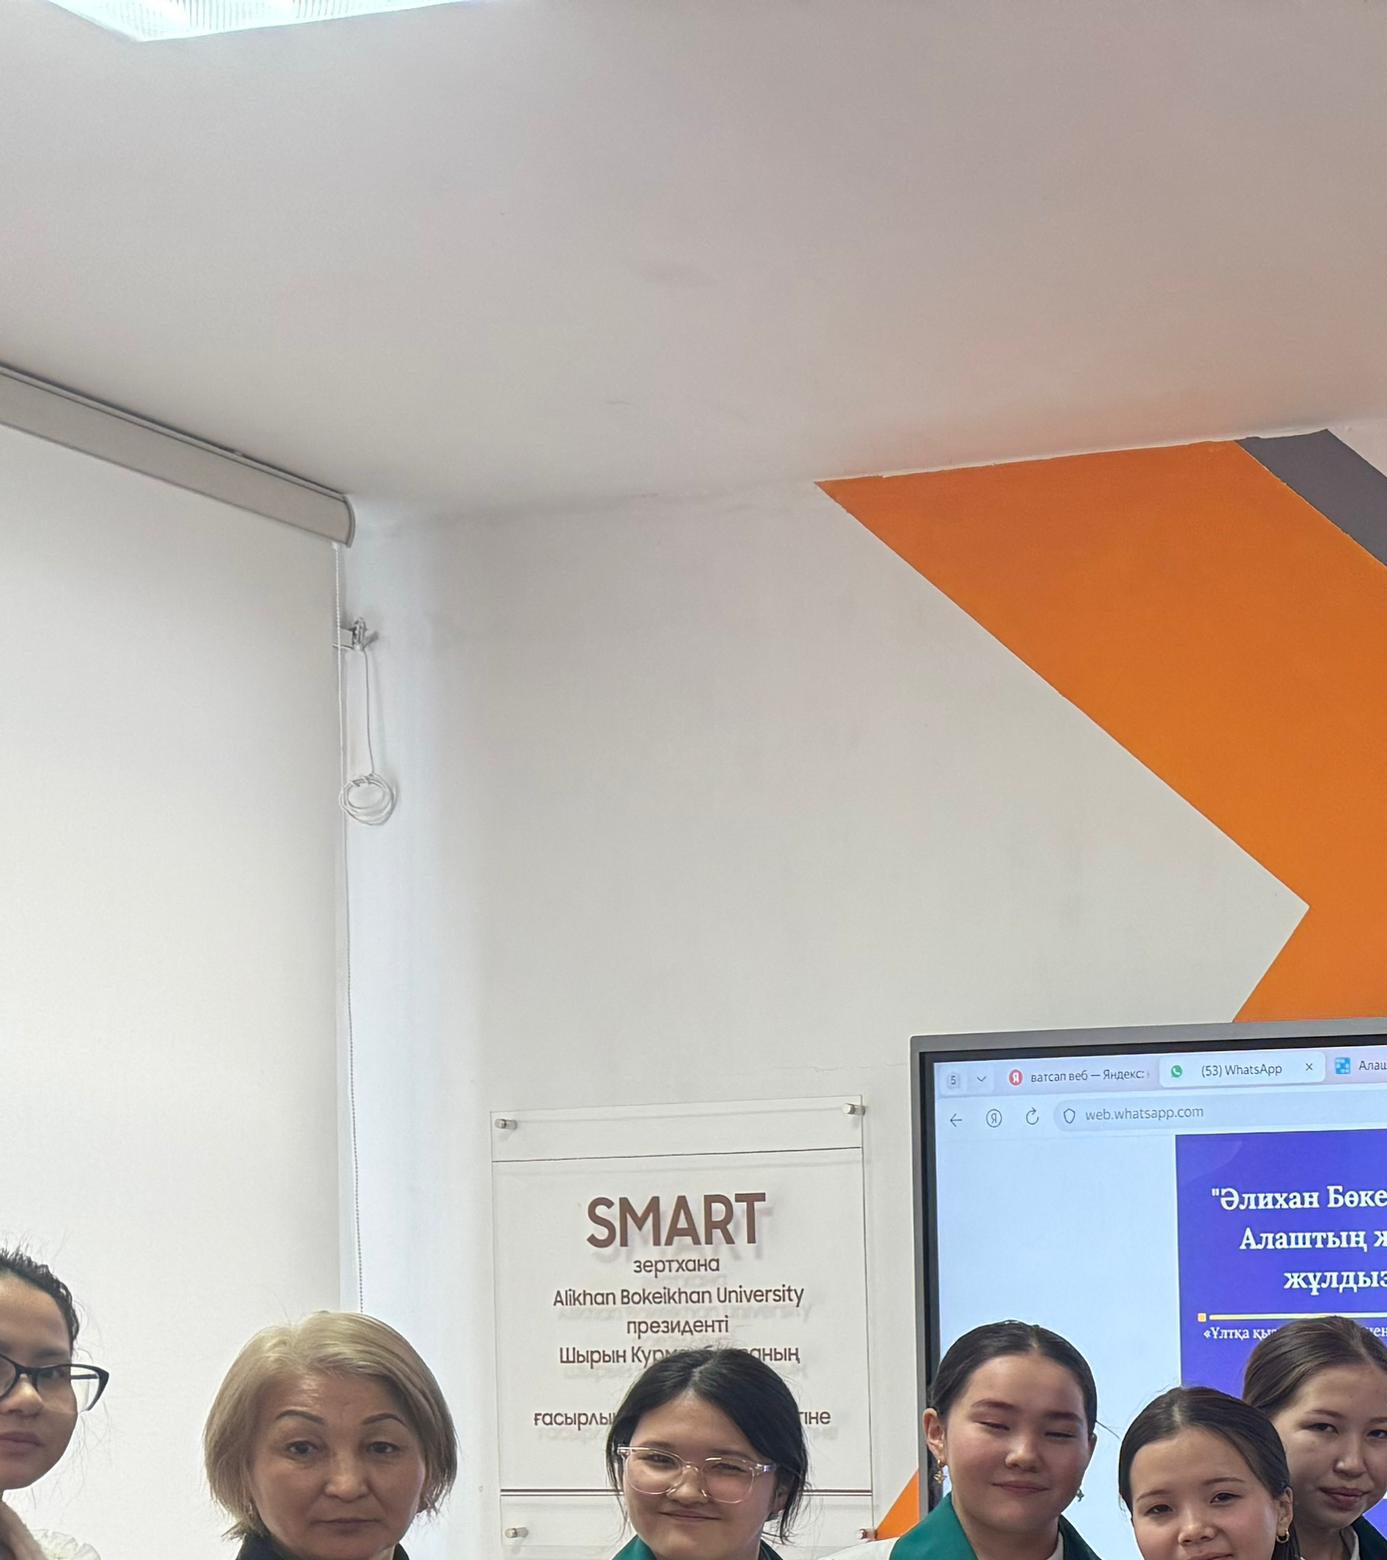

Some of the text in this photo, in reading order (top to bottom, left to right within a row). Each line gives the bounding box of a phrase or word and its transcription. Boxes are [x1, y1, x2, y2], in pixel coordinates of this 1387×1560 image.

[1031, 1073, 1067, 1084] ватсап
[1068, 1070, 1088, 1082] веб
[1201, 1062, 1283, 1079] (53) WhatsApp
[1085, 1105, 1204, 1123] web.whatsapp.com
[1211, 1186, 1320, 1211] "Әлихан
[586, 1192, 766, 1249] SMART
[1239, 1227, 1368, 1252] Алаштың
[633, 1256, 720, 1278] зертхана
[553, 1284, 804, 1307] Alikhan Bokeikhan University
[627, 1315, 729, 1340] президенті
[559, 1346, 626, 1369] Шырын
